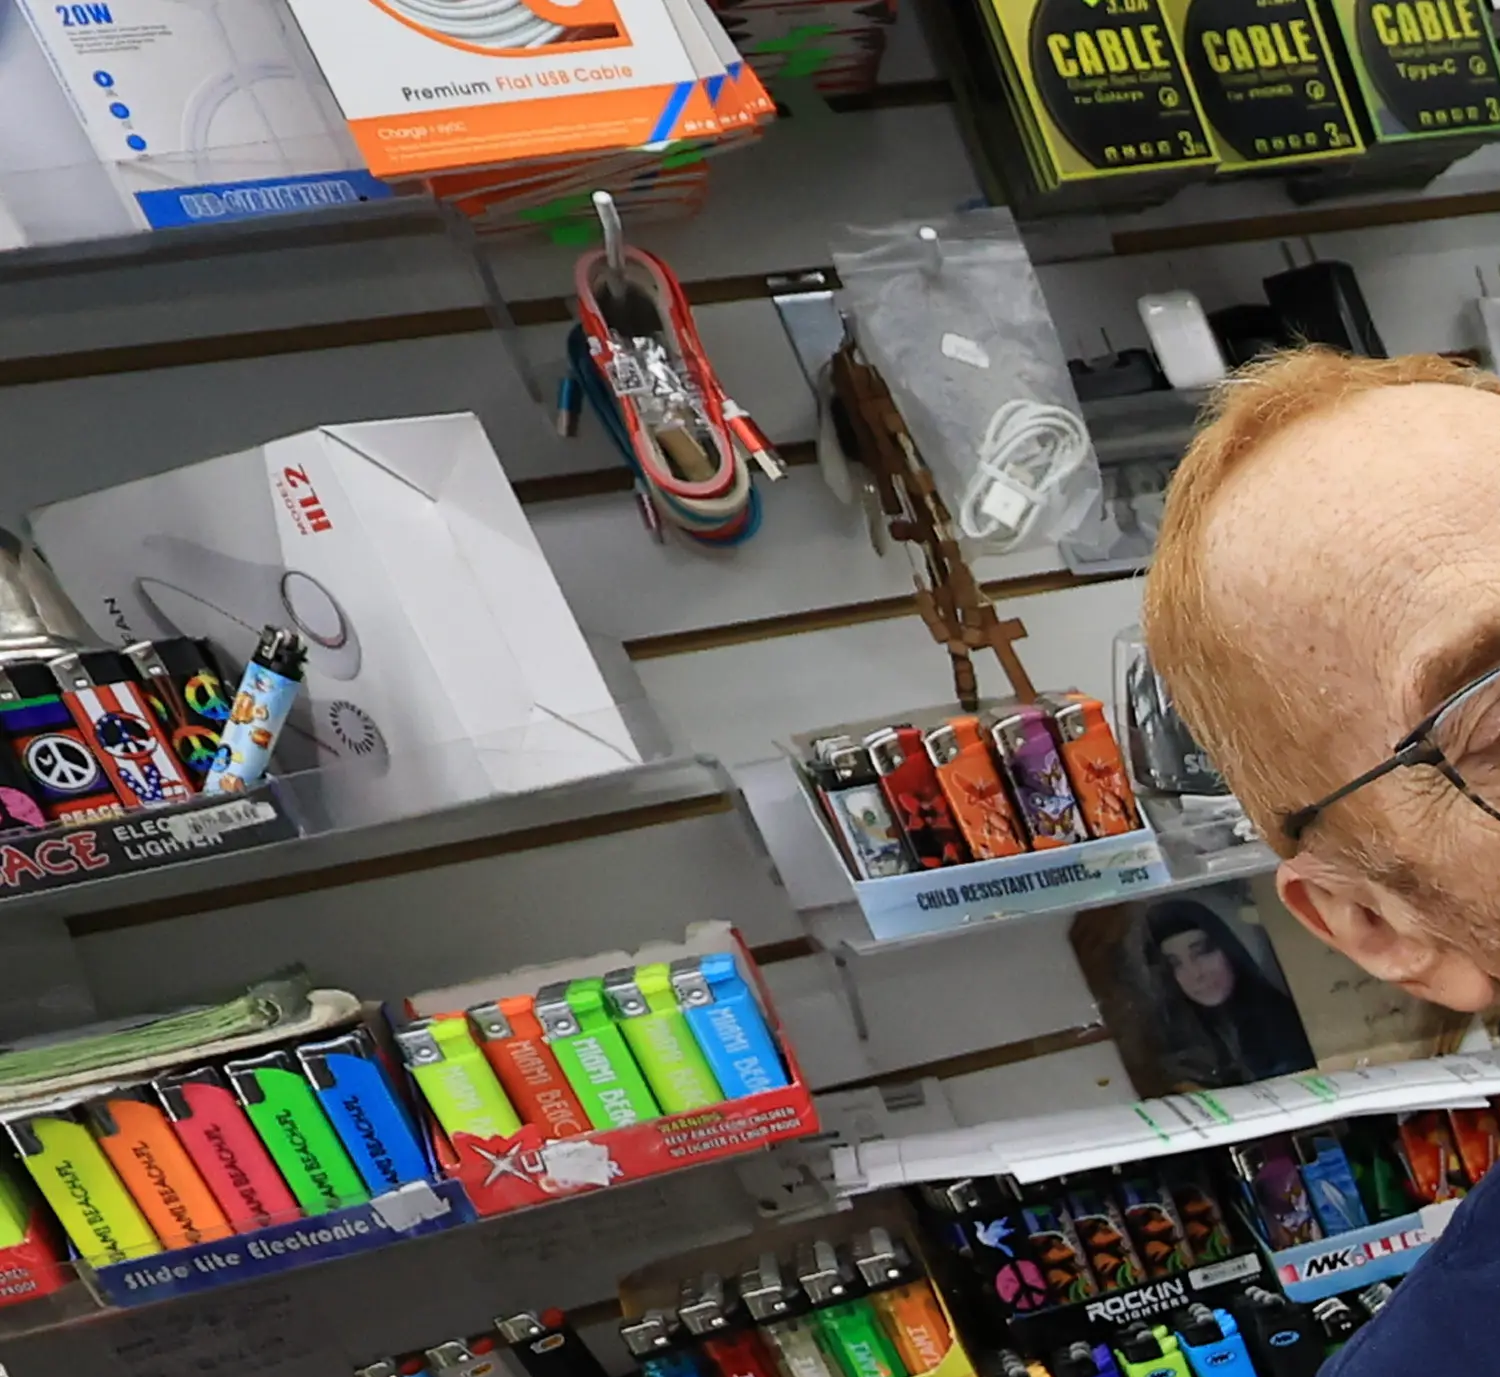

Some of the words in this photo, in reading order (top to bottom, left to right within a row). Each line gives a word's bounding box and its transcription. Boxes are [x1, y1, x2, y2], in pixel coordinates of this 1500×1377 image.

[59, 2, 116, 27] 20W
[1372, 0, 1480, 46] CABLE
[1047, 25, 1169, 79] CABLE
[1202, 20, 1318, 74] CABLE
[401, 75, 492, 103] Premium
[495, 73, 540, 95] Flat
[544, 70, 581, 88] USB
[584, 62, 634, 84] Cable
[283, 462, 334, 535] HL2
[59, 803, 124, 825] PEACE
[915, 885, 959, 912] CHILD
[960, 869, 1032, 906] RESISTANT
[706, 1007, 750, 1054] MIAMI
[506, 1039, 552, 1087] MIAMI
[124, 1270, 188, 1290] Slide
[247, 1222, 369, 1260] Electronic
[1085, 1278, 1185, 1323] ROCKIN
[1115, 1295, 1191, 1325] LIGHTERS
